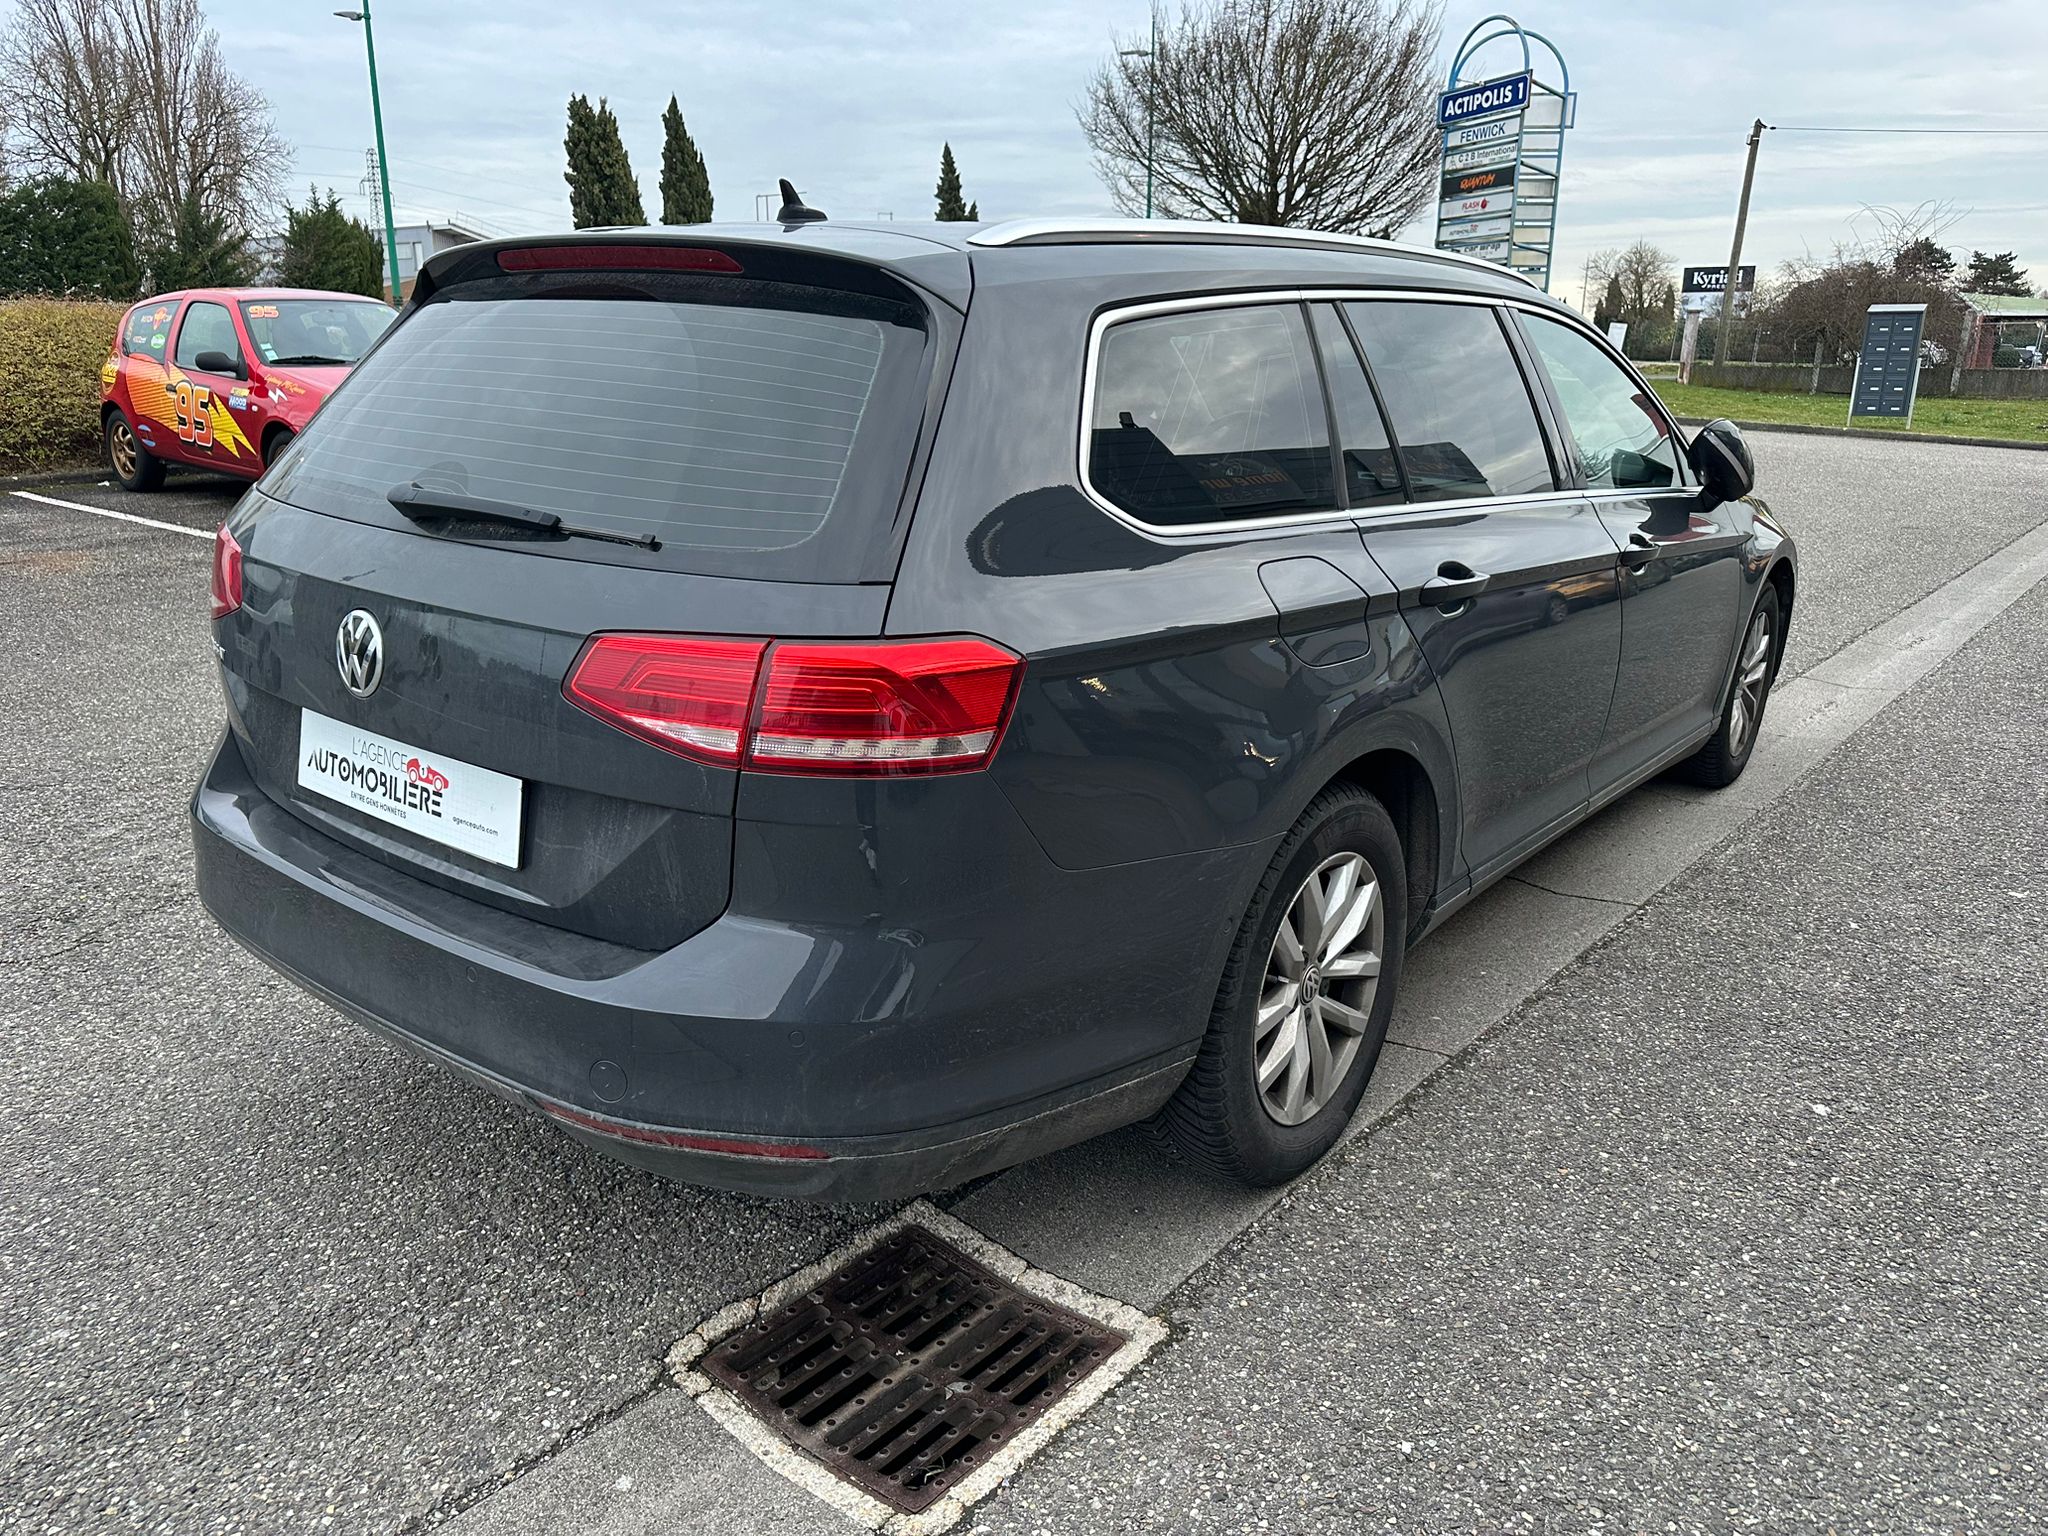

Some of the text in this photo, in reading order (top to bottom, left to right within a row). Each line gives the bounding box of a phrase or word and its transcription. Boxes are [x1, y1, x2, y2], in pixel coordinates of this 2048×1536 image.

[1444, 82, 1524, 117] ACTIPOLIS 1
[1460, 122, 1506, 143] FENWICK
[1458, 154, 1464, 163] C
[1476, 145, 1517, 159] International
[249, 305, 279, 319] 95
[175, 381, 213, 447] 95
[352, 737, 408, 773] L'AGENCE
[351, 790, 366, 803] ENTRE
[366, 796, 380, 809] GENS
[452, 816, 499, 837] agenceauto.com
